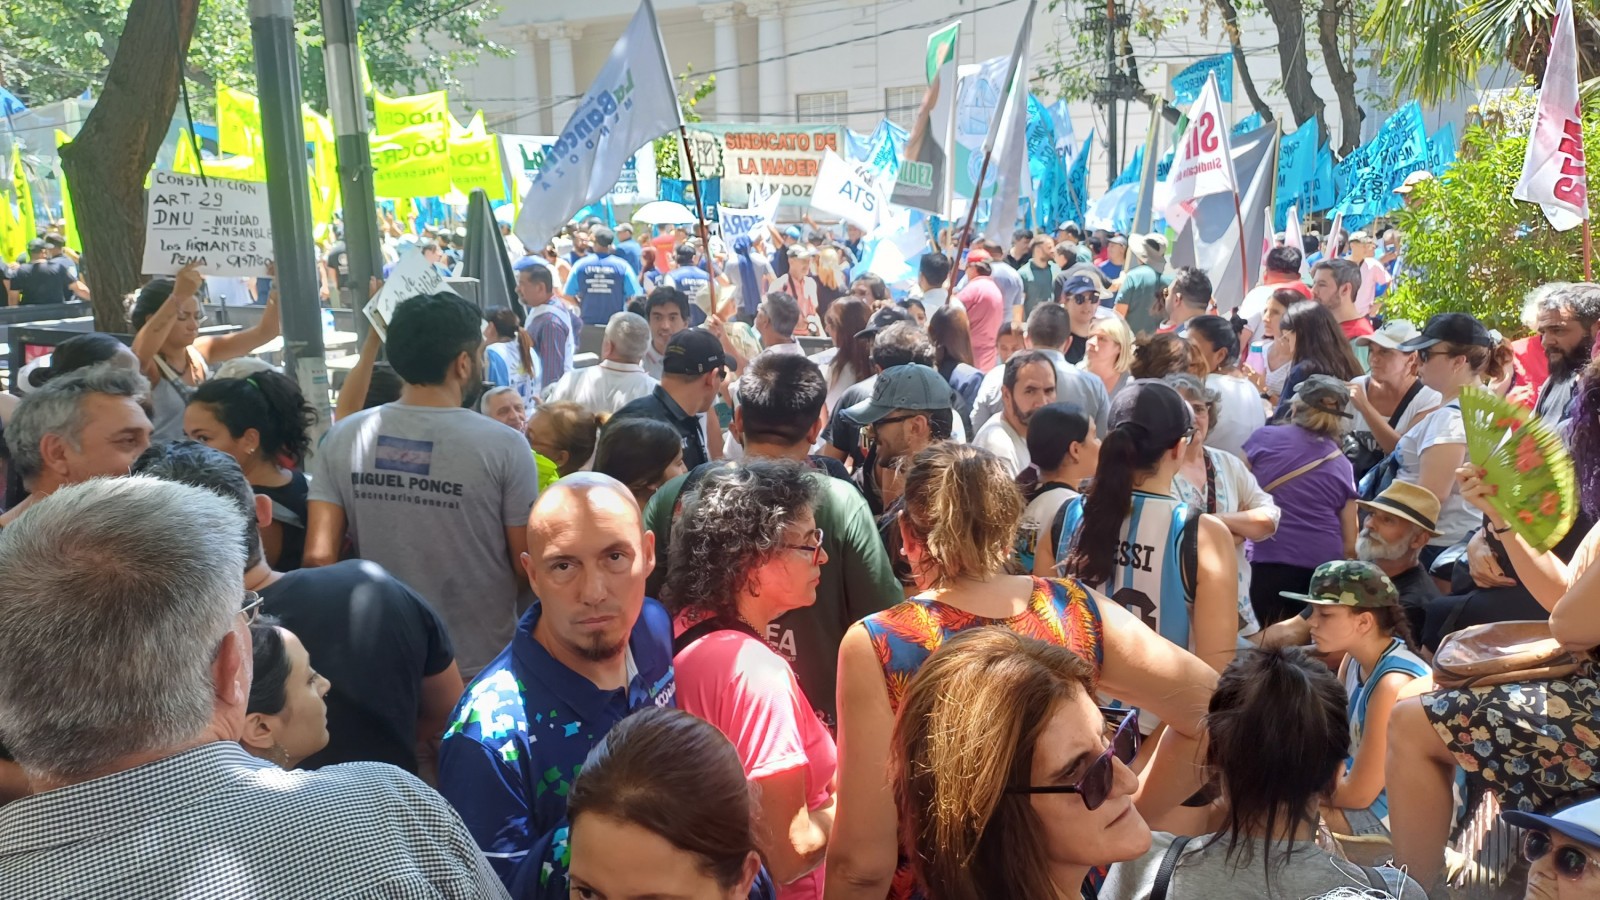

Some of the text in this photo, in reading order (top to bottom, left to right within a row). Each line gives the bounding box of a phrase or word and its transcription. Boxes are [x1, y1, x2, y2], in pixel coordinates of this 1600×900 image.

[724, 132, 837, 151] SINDICATO DE
[738, 157, 822, 176] LA MADER
[156, 172, 257, 195] CONSTTUCION
[198, 192, 223, 207] 29
[838, 179, 876, 212] ATS
[152, 209, 194, 226] DNU
[351, 471, 464, 497] MIGUEL PONCE
[414, 495, 460, 510] General
